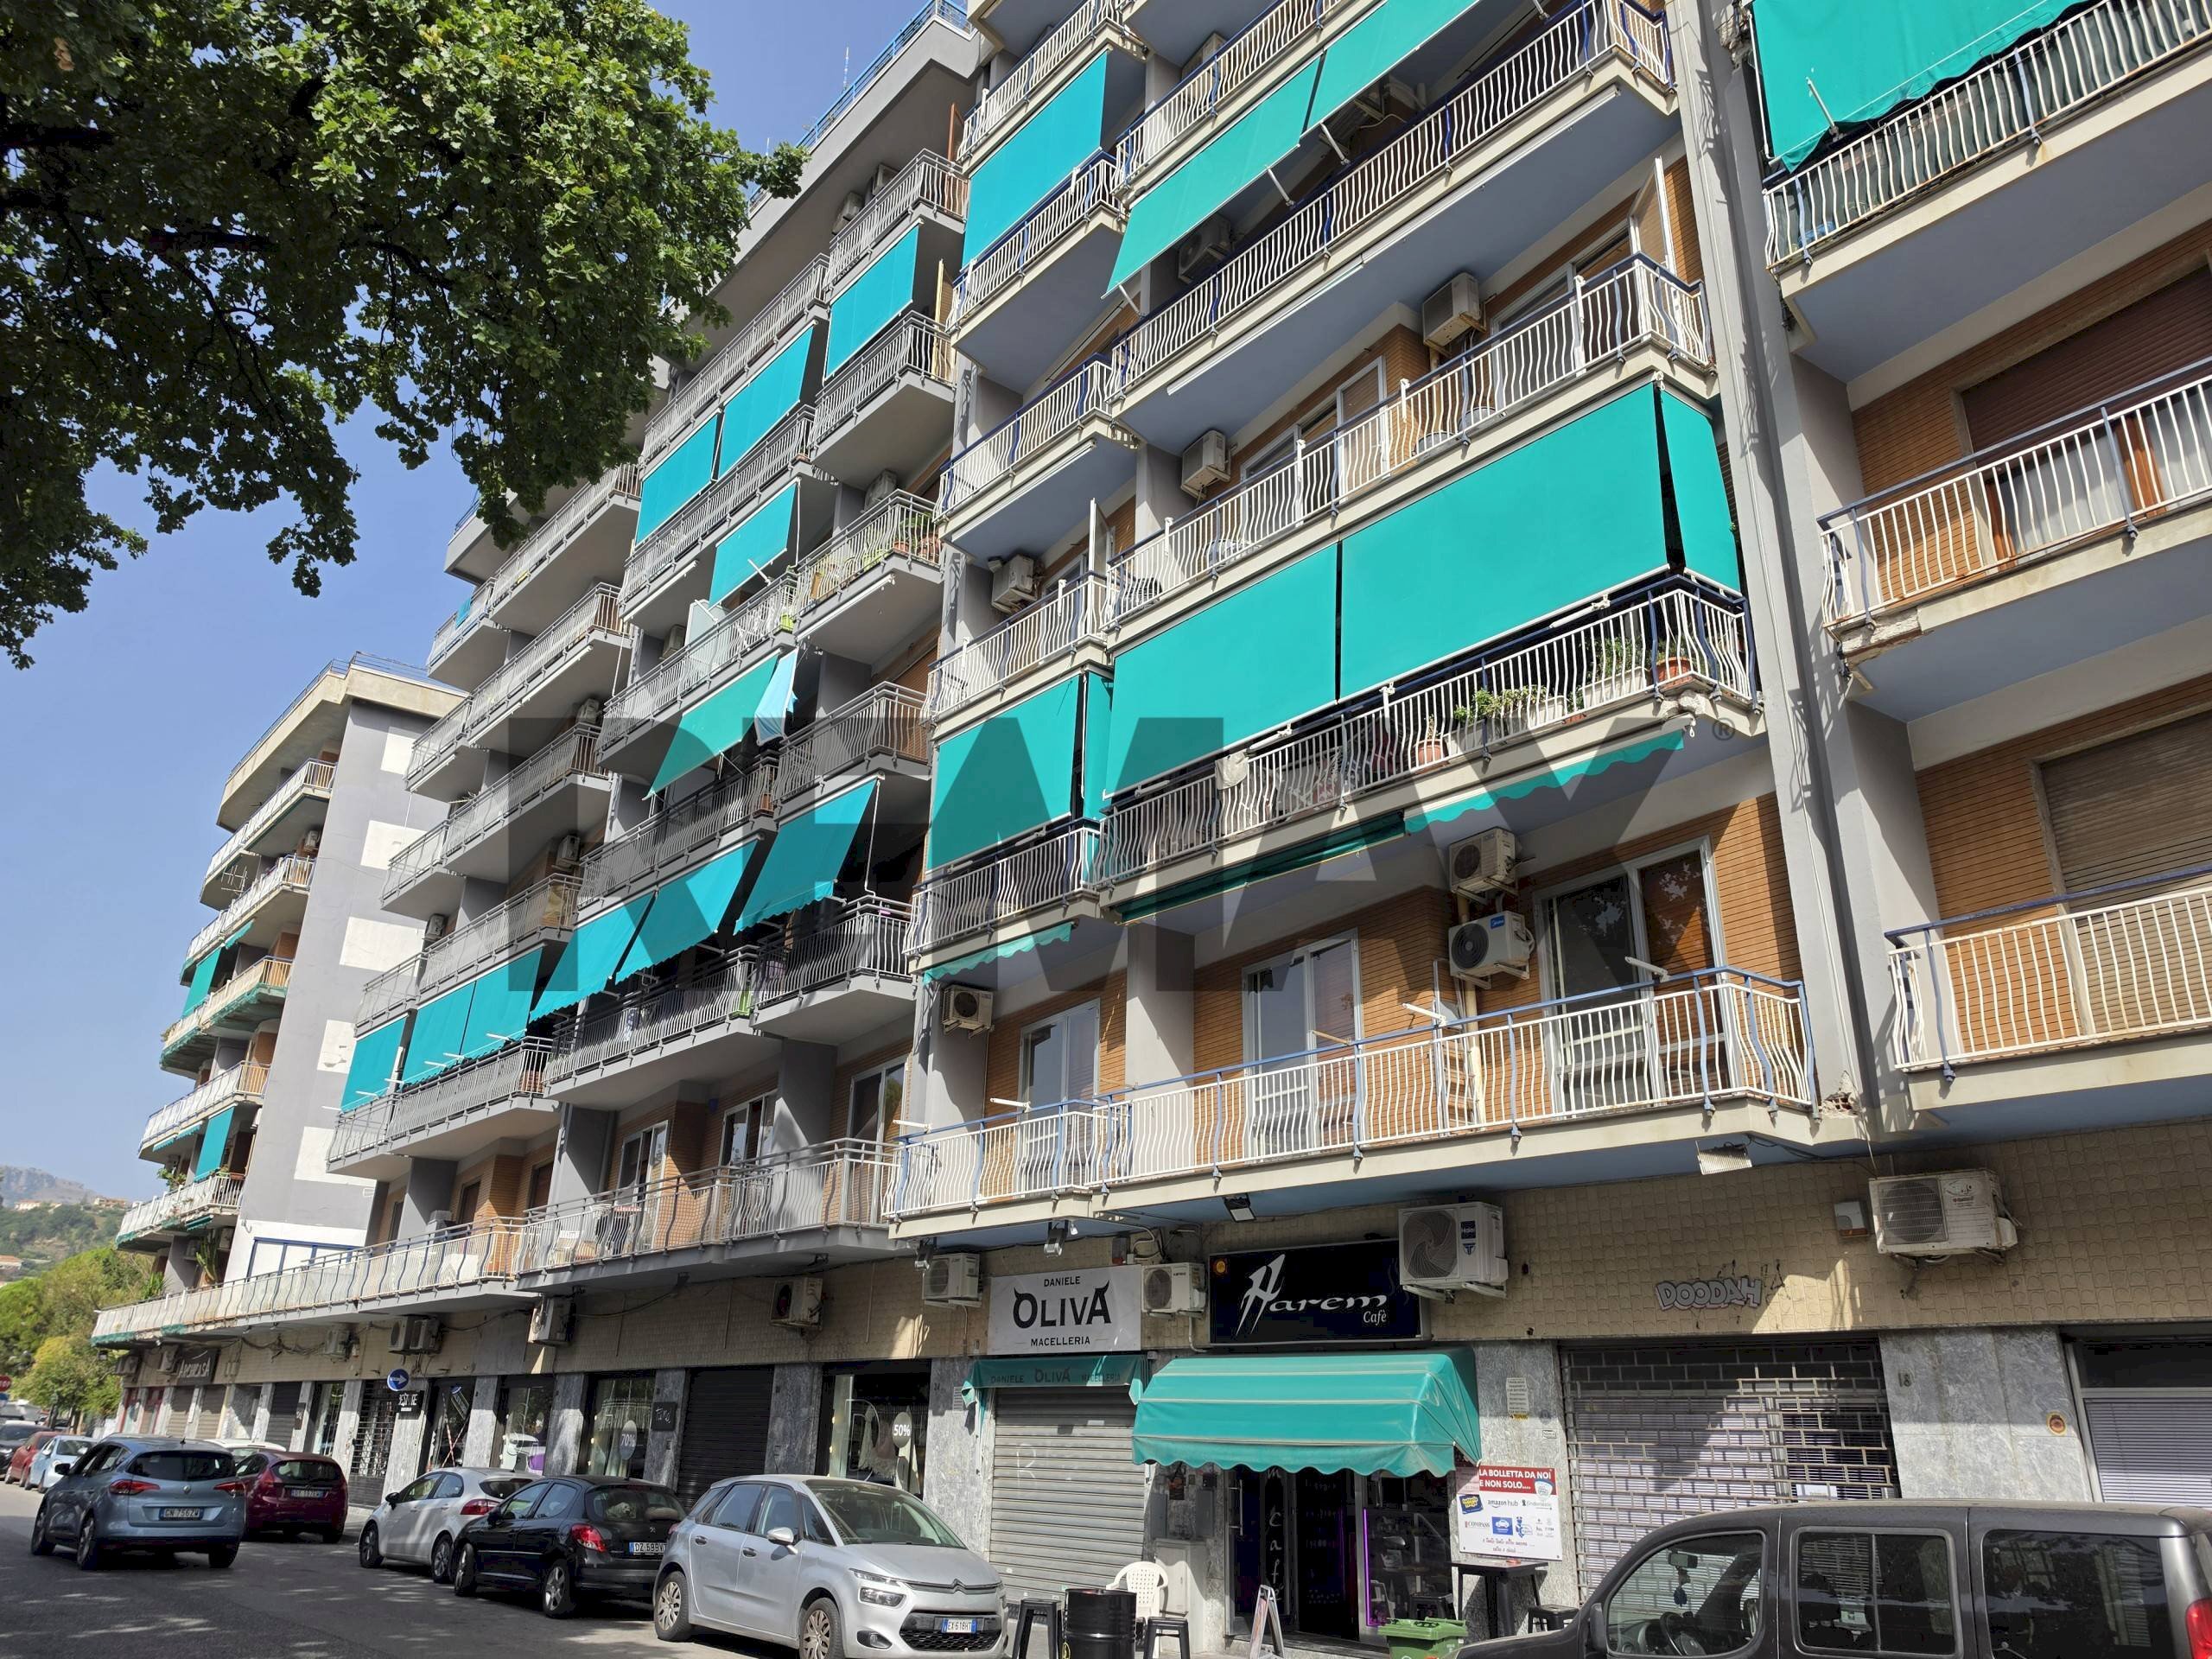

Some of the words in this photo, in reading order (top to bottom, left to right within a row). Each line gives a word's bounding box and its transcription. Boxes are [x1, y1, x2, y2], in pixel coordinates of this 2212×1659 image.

[1044, 1276, 1080, 1287] DANIELE
[1236, 1254, 1387, 1335] Harem
[1655, 1277, 1763, 1311] DOODAH
[1013, 1280, 1112, 1329] OLIVA
[1363, 1309, 1387, 1326] Cafè
[1031, 1337, 1090, 1347] MACELLERIA
[991, 1375, 1024, 1383] DANIELE
[1034, 1367, 1071, 1382] OLIVA
[893, 1424, 911, 1436] 50%
[621, 1433, 636, 1447] 70%
[1489, 1469, 1524, 1478] BOLLETTA
[1484, 1479, 1502, 1488] NON
